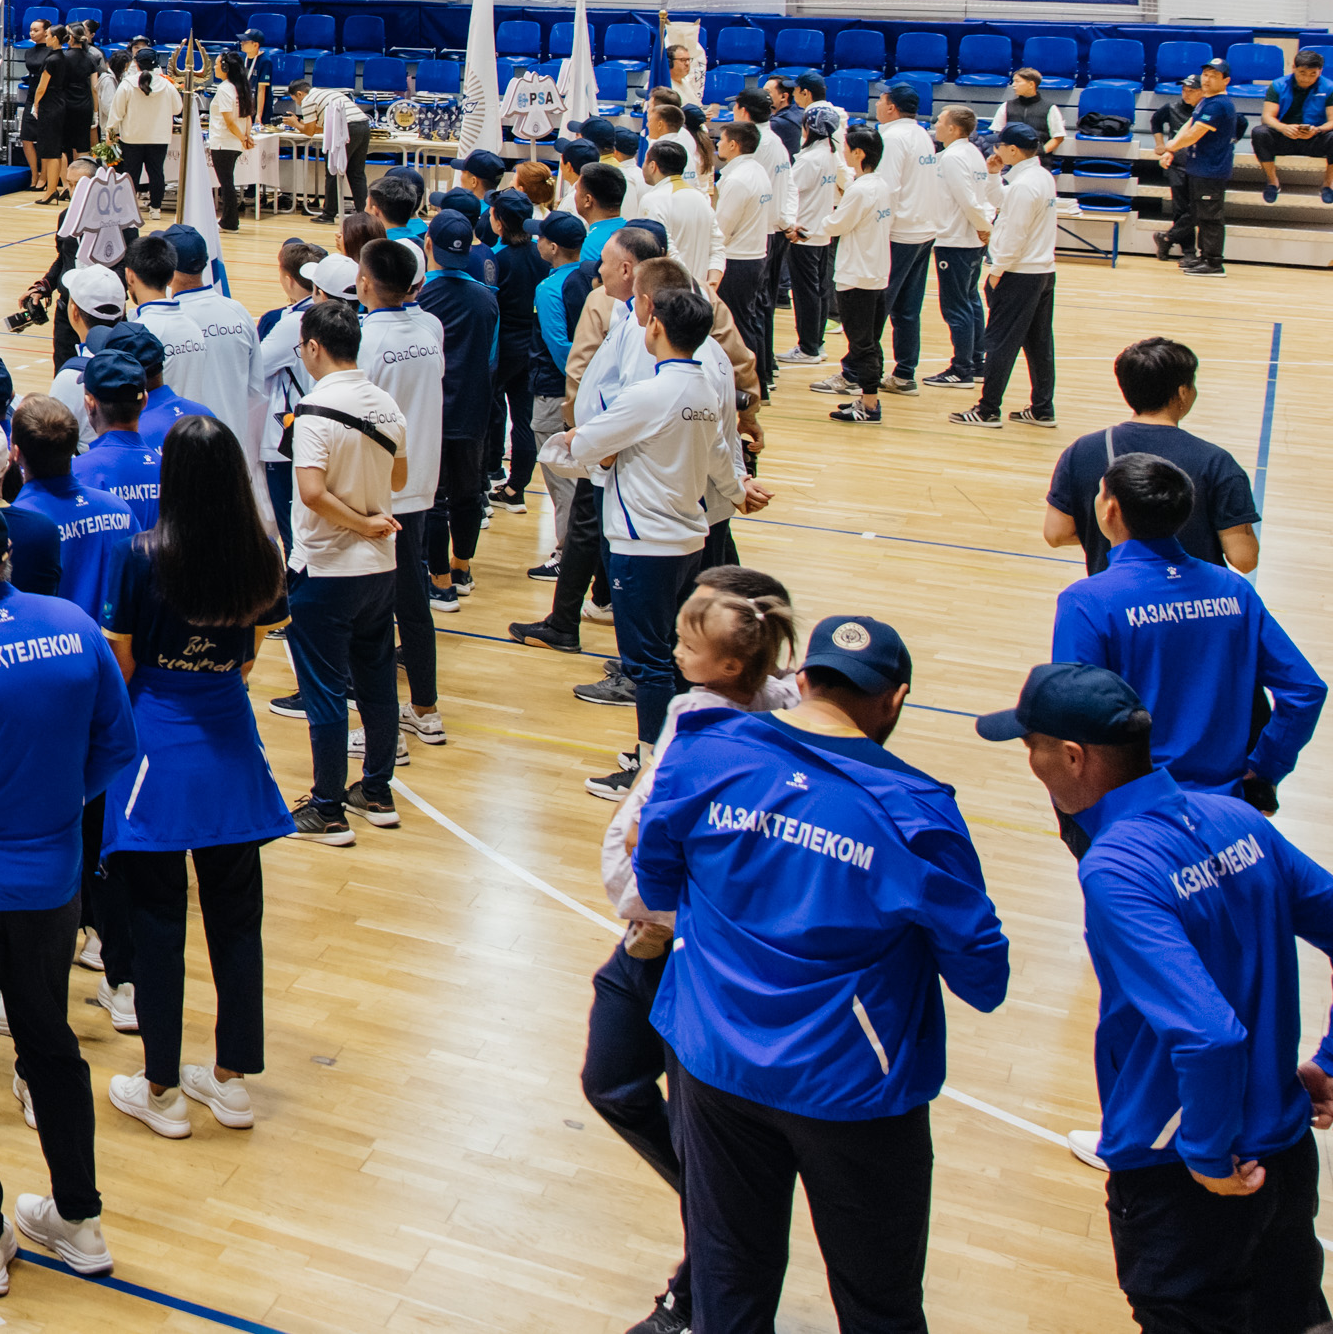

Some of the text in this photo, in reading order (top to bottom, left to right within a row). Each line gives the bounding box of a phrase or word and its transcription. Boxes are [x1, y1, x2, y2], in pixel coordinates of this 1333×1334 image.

[529, 91, 554, 106] PSA
[97, 185, 123, 215] QC
[58, 513, 131, 542] ЗАҚТЕЛЕКОМ
[1126, 596, 1241, 628] ҚАЗАҚТЕЛЕКОМ
[183, 635, 217, 656] Bir
[707, 801, 875, 870] ҚАЗАҚТЕЛЕКОМ
